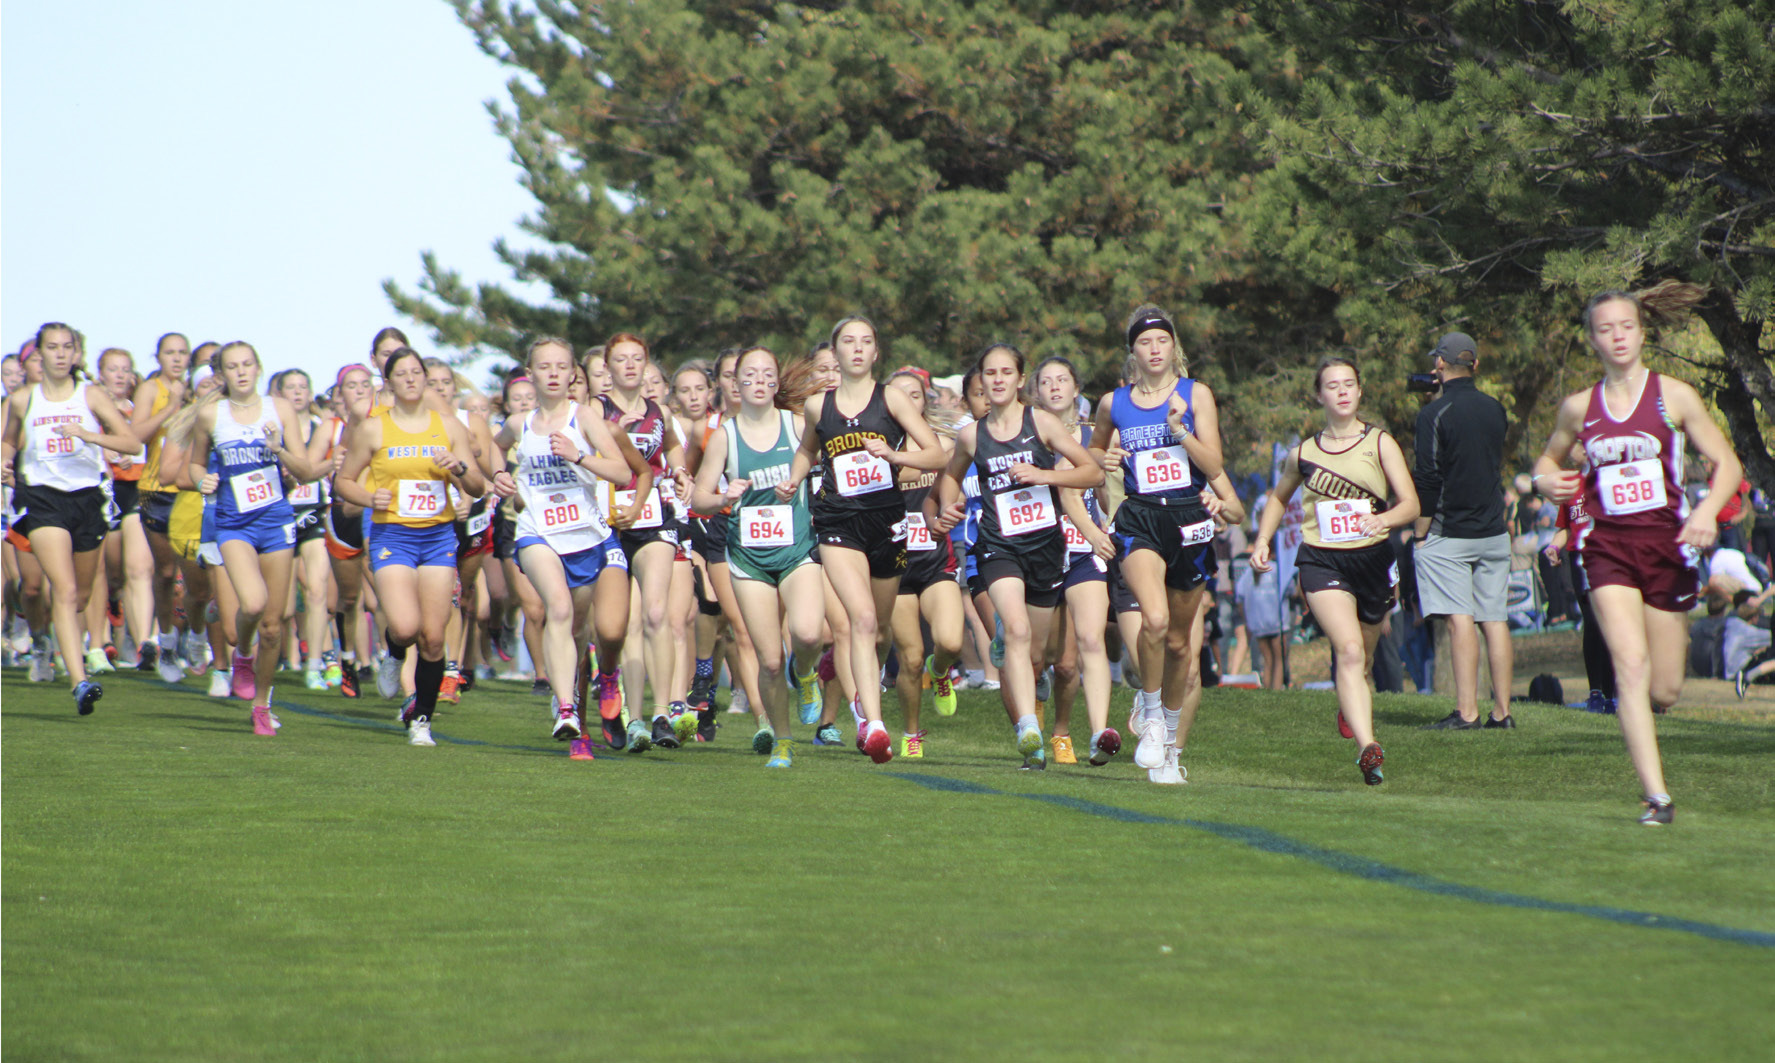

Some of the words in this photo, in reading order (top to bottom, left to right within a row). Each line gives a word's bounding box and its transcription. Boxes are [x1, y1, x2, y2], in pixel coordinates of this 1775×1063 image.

[33, 415, 83, 427] AINSWORTH
[1121, 423, 1190, 444] CORNERST
[1125, 437, 1179, 450] CHRISTIA
[46, 437, 74, 453] 610
[388, 446, 417, 458] WEST
[221, 446, 279, 466] BRONCOS
[530, 454, 567, 469] LHNE
[987, 450, 1034, 472] NORTH
[528, 470, 577, 486] EAGLES
[749, 463, 790, 491] IRISH
[845, 465, 883, 487] 684
[1146, 462, 1181, 484] 636
[246, 482, 274, 503] 631
[408, 494, 437, 511] 726
[1612, 480, 1654, 505] 638
[544, 504, 580, 526] 680
[1009, 502, 1046, 526] 692
[1330, 514, 1360, 534] 613
[750, 521, 784, 539] 694
[909, 527, 929, 543] 79
[1191, 525, 1211, 541] 636
